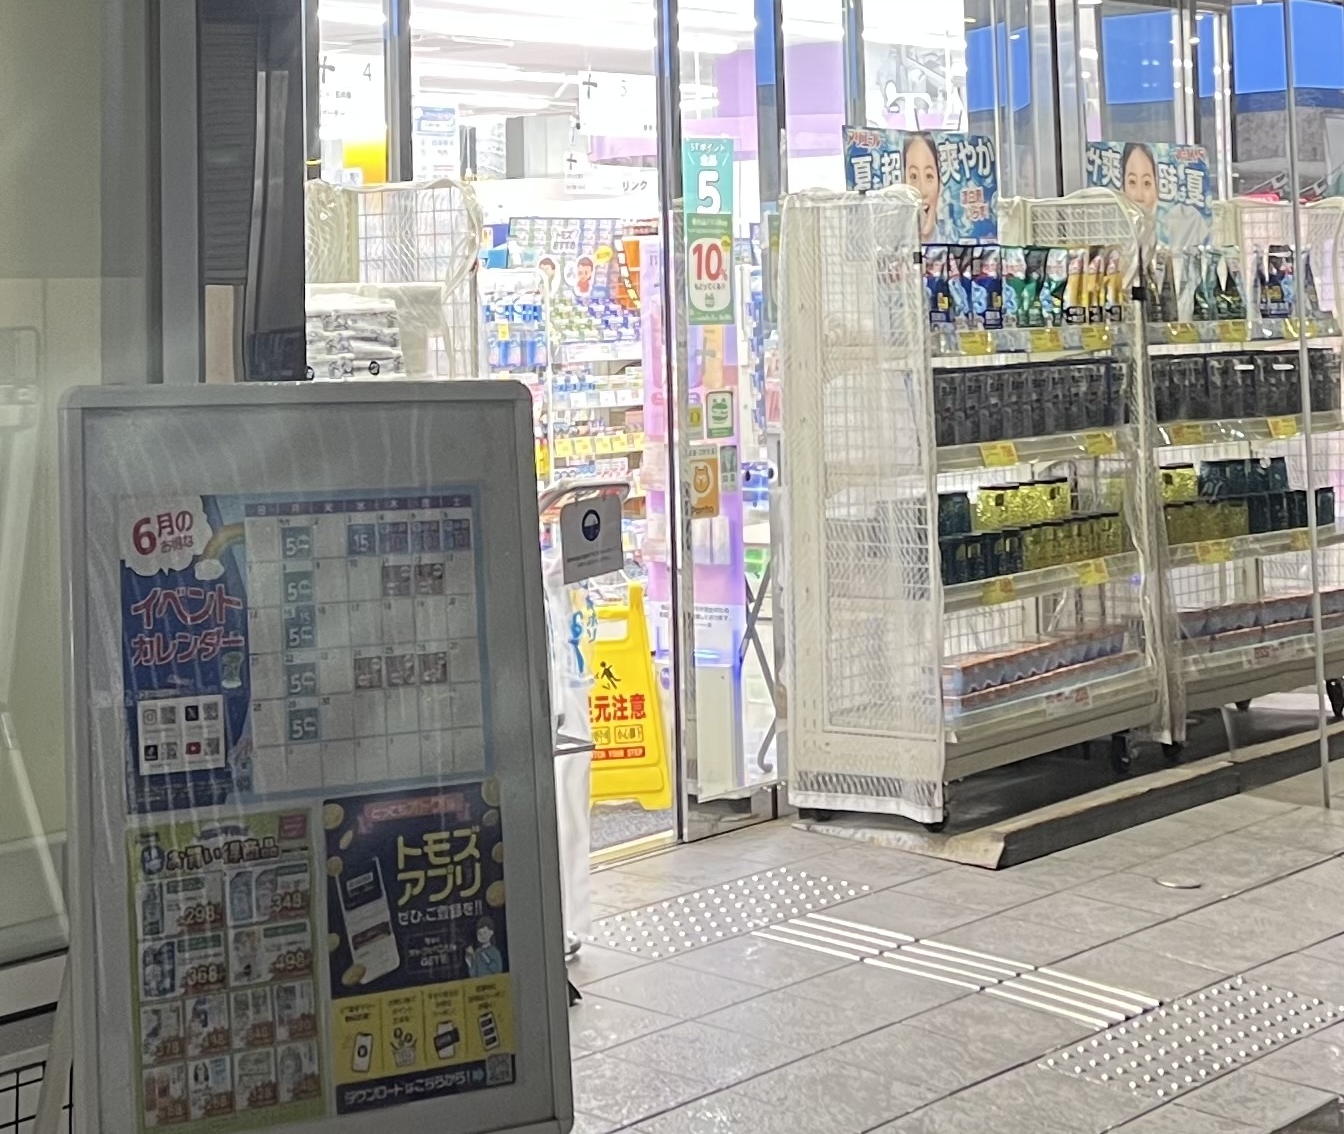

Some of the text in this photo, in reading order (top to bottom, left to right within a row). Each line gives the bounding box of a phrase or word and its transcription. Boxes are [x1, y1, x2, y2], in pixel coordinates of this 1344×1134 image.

[937, 137, 996, 185] 爽やか
[696, 169, 722, 214] 5
[132, 511, 194, 556] 6月の
[131, 583, 244, 630] イベント
[131, 626, 245, 666] カレンダー
[397, 826, 481, 870] トモズ
[397, 862, 482, 906] アプリ
[186, 964, 219, 985] 368
